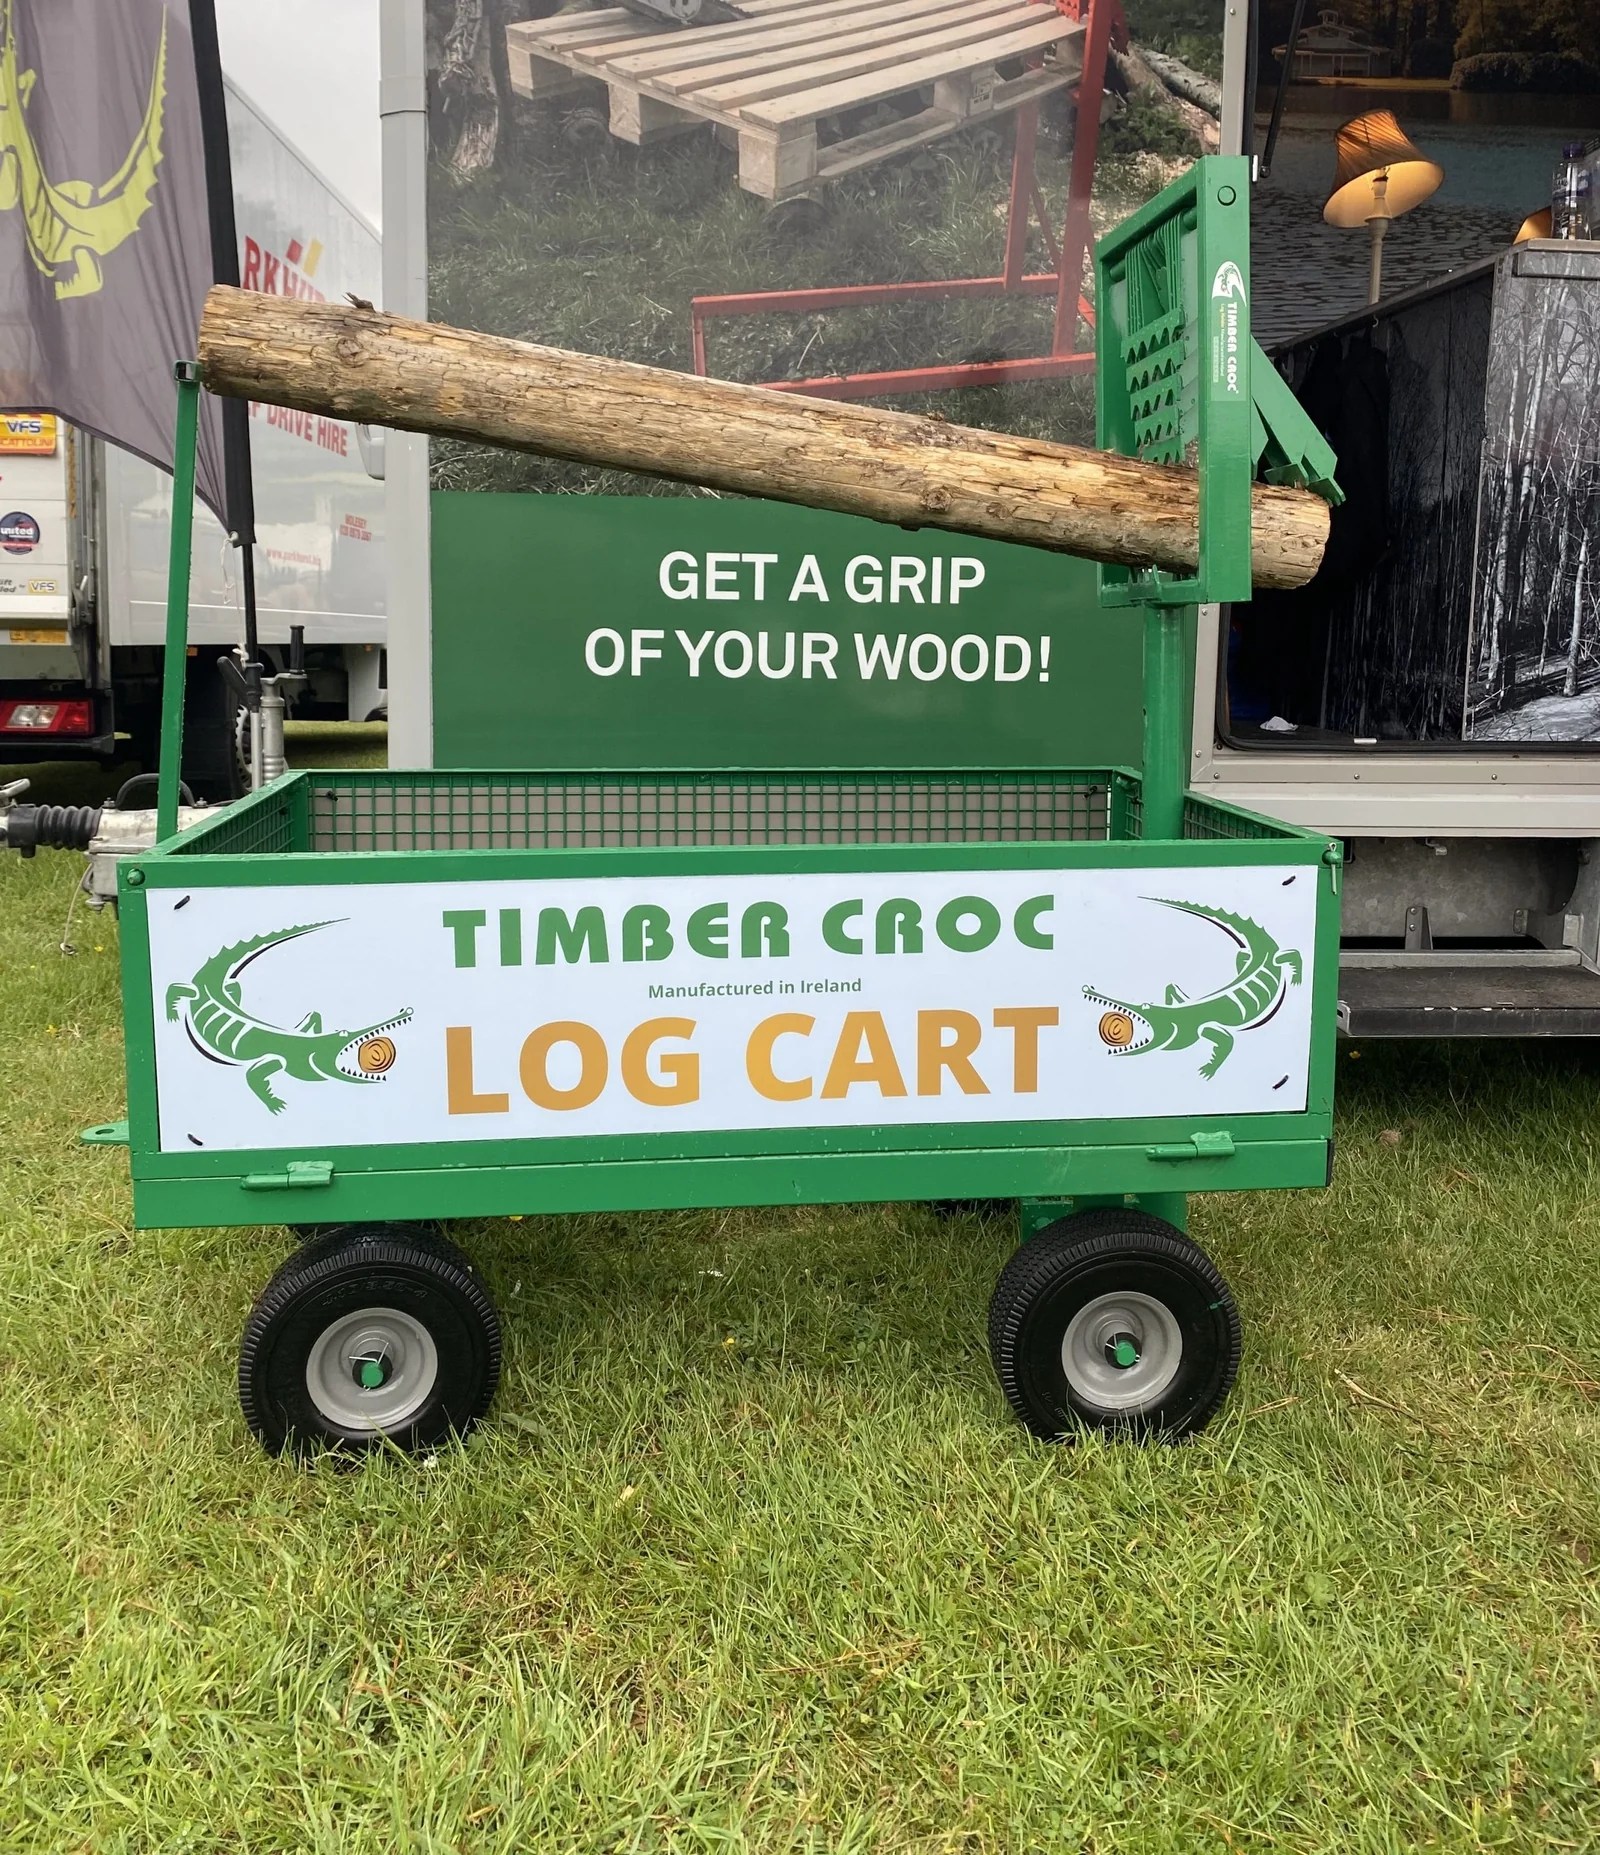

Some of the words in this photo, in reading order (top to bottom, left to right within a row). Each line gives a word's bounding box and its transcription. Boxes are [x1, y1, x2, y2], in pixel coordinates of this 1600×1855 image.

[1227, 302, 1238, 352] TIMBER
[1227, 356, 1238, 392] CROC
[7, 421, 41, 433] VFS
[267, 406, 312, 442] DRIVE
[317, 417, 348, 458] HIRE
[1, 527, 33, 535] united
[31, 582, 55, 590] VFS
[660, 551, 778, 600] GET
[789, 555, 829, 601] A
[845, 555, 985, 603] GRIP
[586, 628, 665, 676] OF
[675, 630, 839, 679] YOUR
[854, 633, 1051, 682] WOOD!
[443, 901, 790, 968] TIMBER
[822, 894, 1055, 954] CROC
[648, 980, 774, 998] Manufactured
[779, 981, 795, 995] in
[801, 978, 862, 993] Ireland
[446, 1017, 700, 1115] LOG
[746, 1006, 1059, 1102] CART
